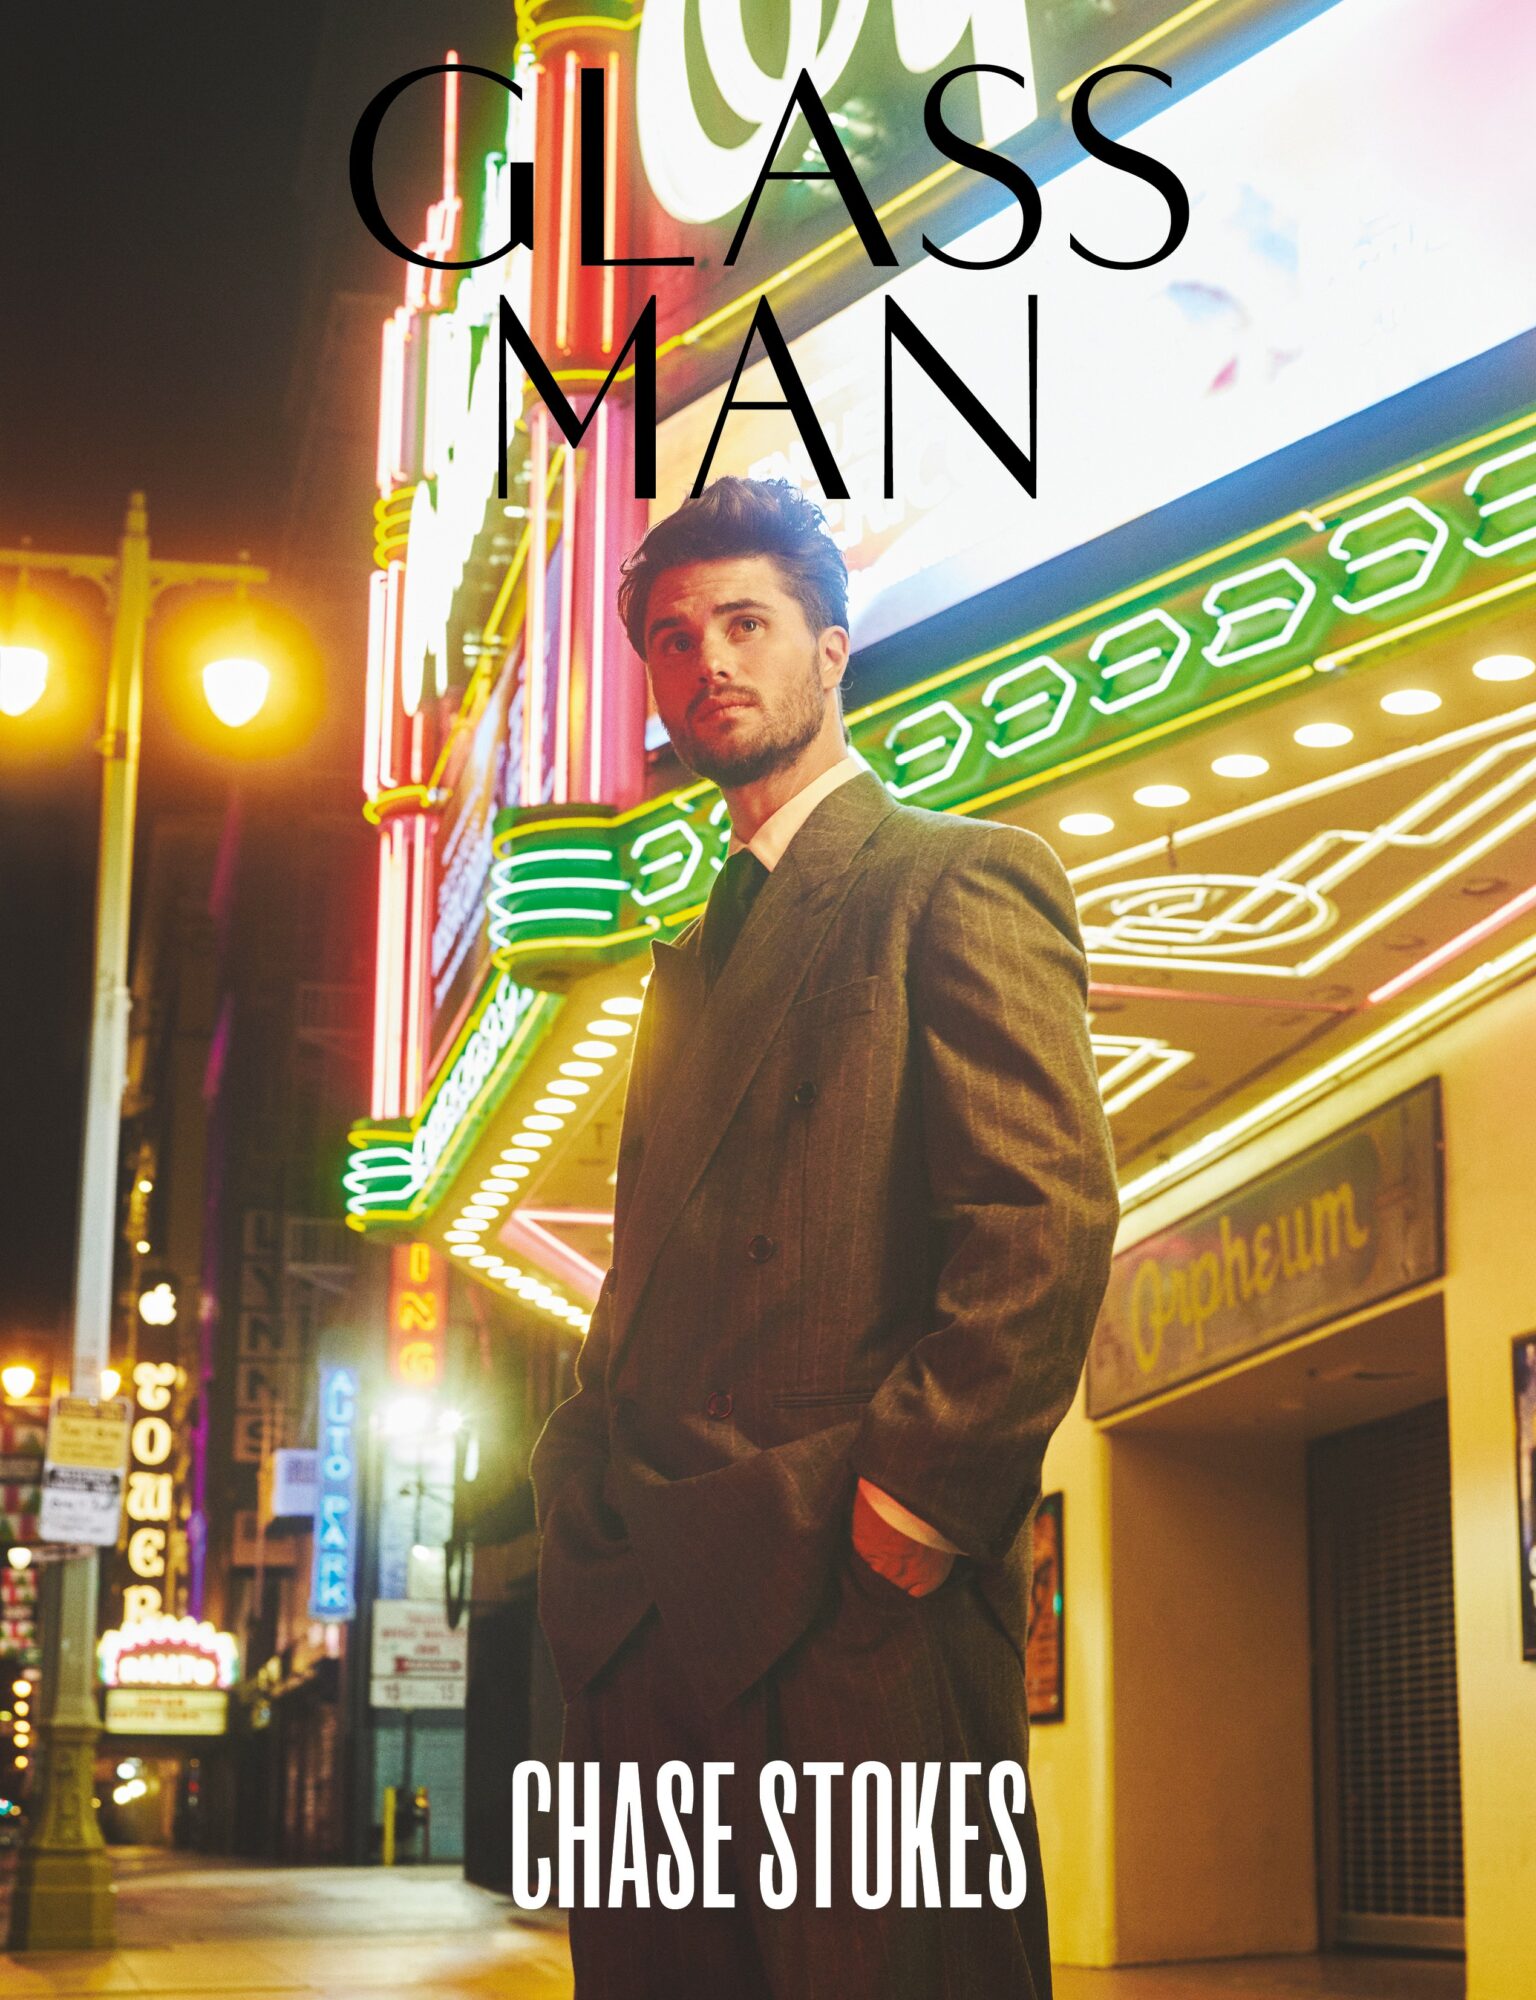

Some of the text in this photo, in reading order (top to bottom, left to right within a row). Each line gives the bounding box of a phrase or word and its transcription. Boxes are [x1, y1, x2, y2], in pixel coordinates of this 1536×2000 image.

[1131, 1183, 1371, 1374] Orpheum
[125, 1361, 176, 1626] TOWER
[320, 1370, 354, 1607] AUTO PARK
